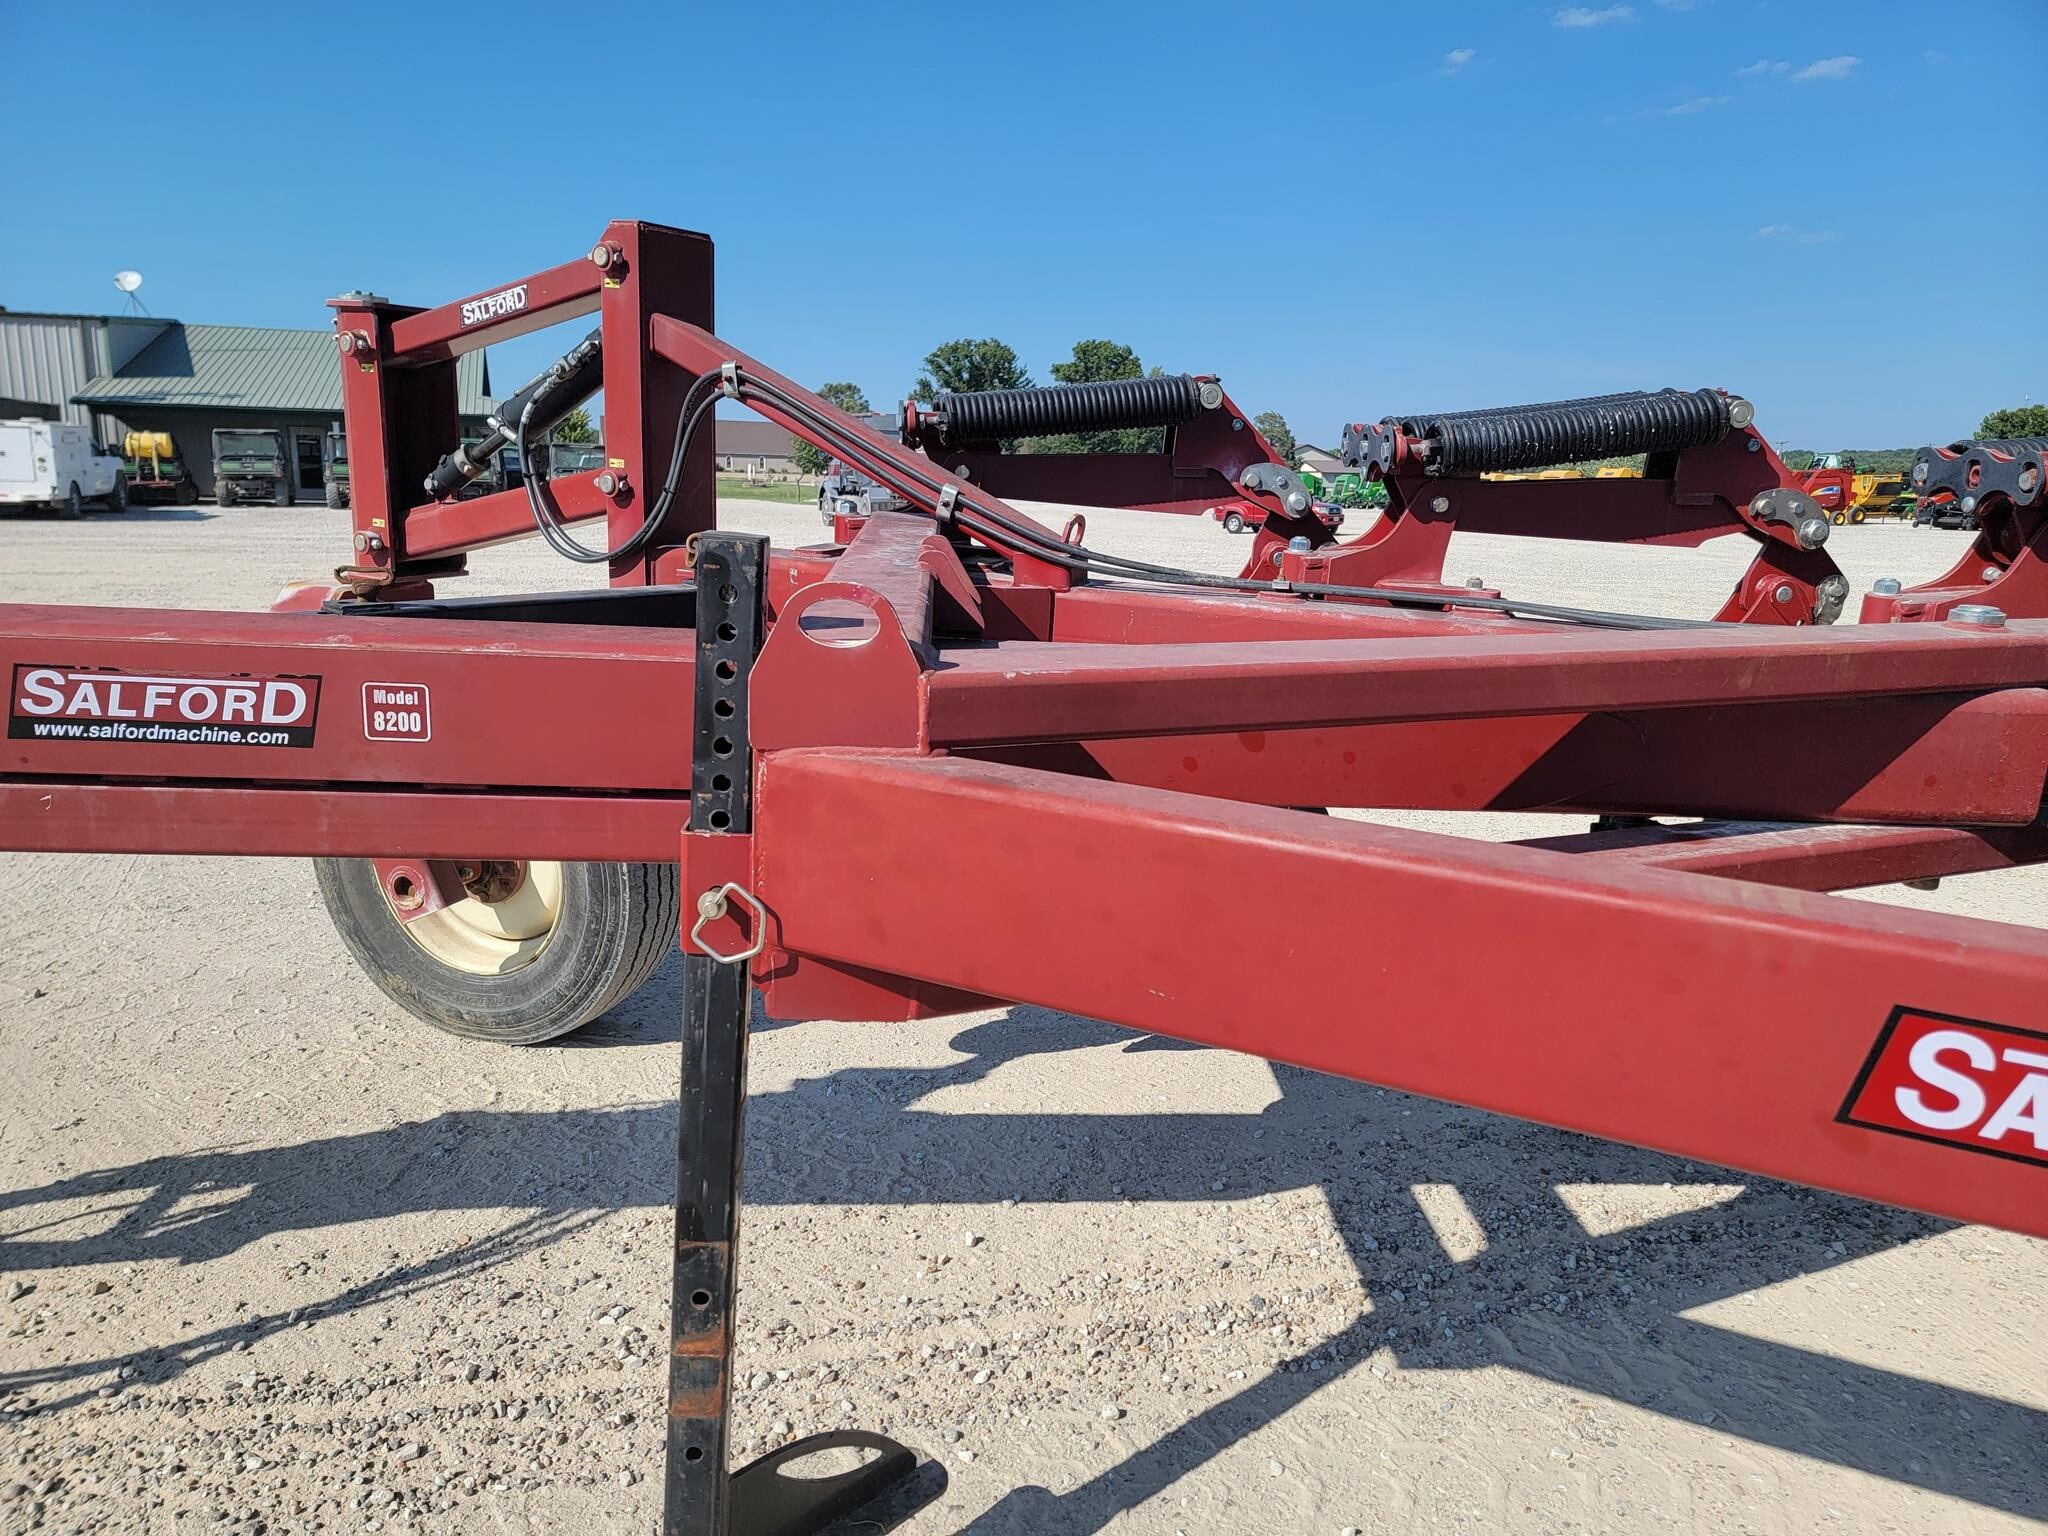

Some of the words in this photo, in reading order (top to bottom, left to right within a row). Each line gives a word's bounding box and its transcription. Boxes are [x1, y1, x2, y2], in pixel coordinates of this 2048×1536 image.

[462, 286, 526, 325] SALFORD
[20, 669, 308, 724] SALFORD
[373, 689, 419, 705] Model
[374, 710, 421, 732] 8200
[34, 722, 289, 745] www.salfordmachine.com
